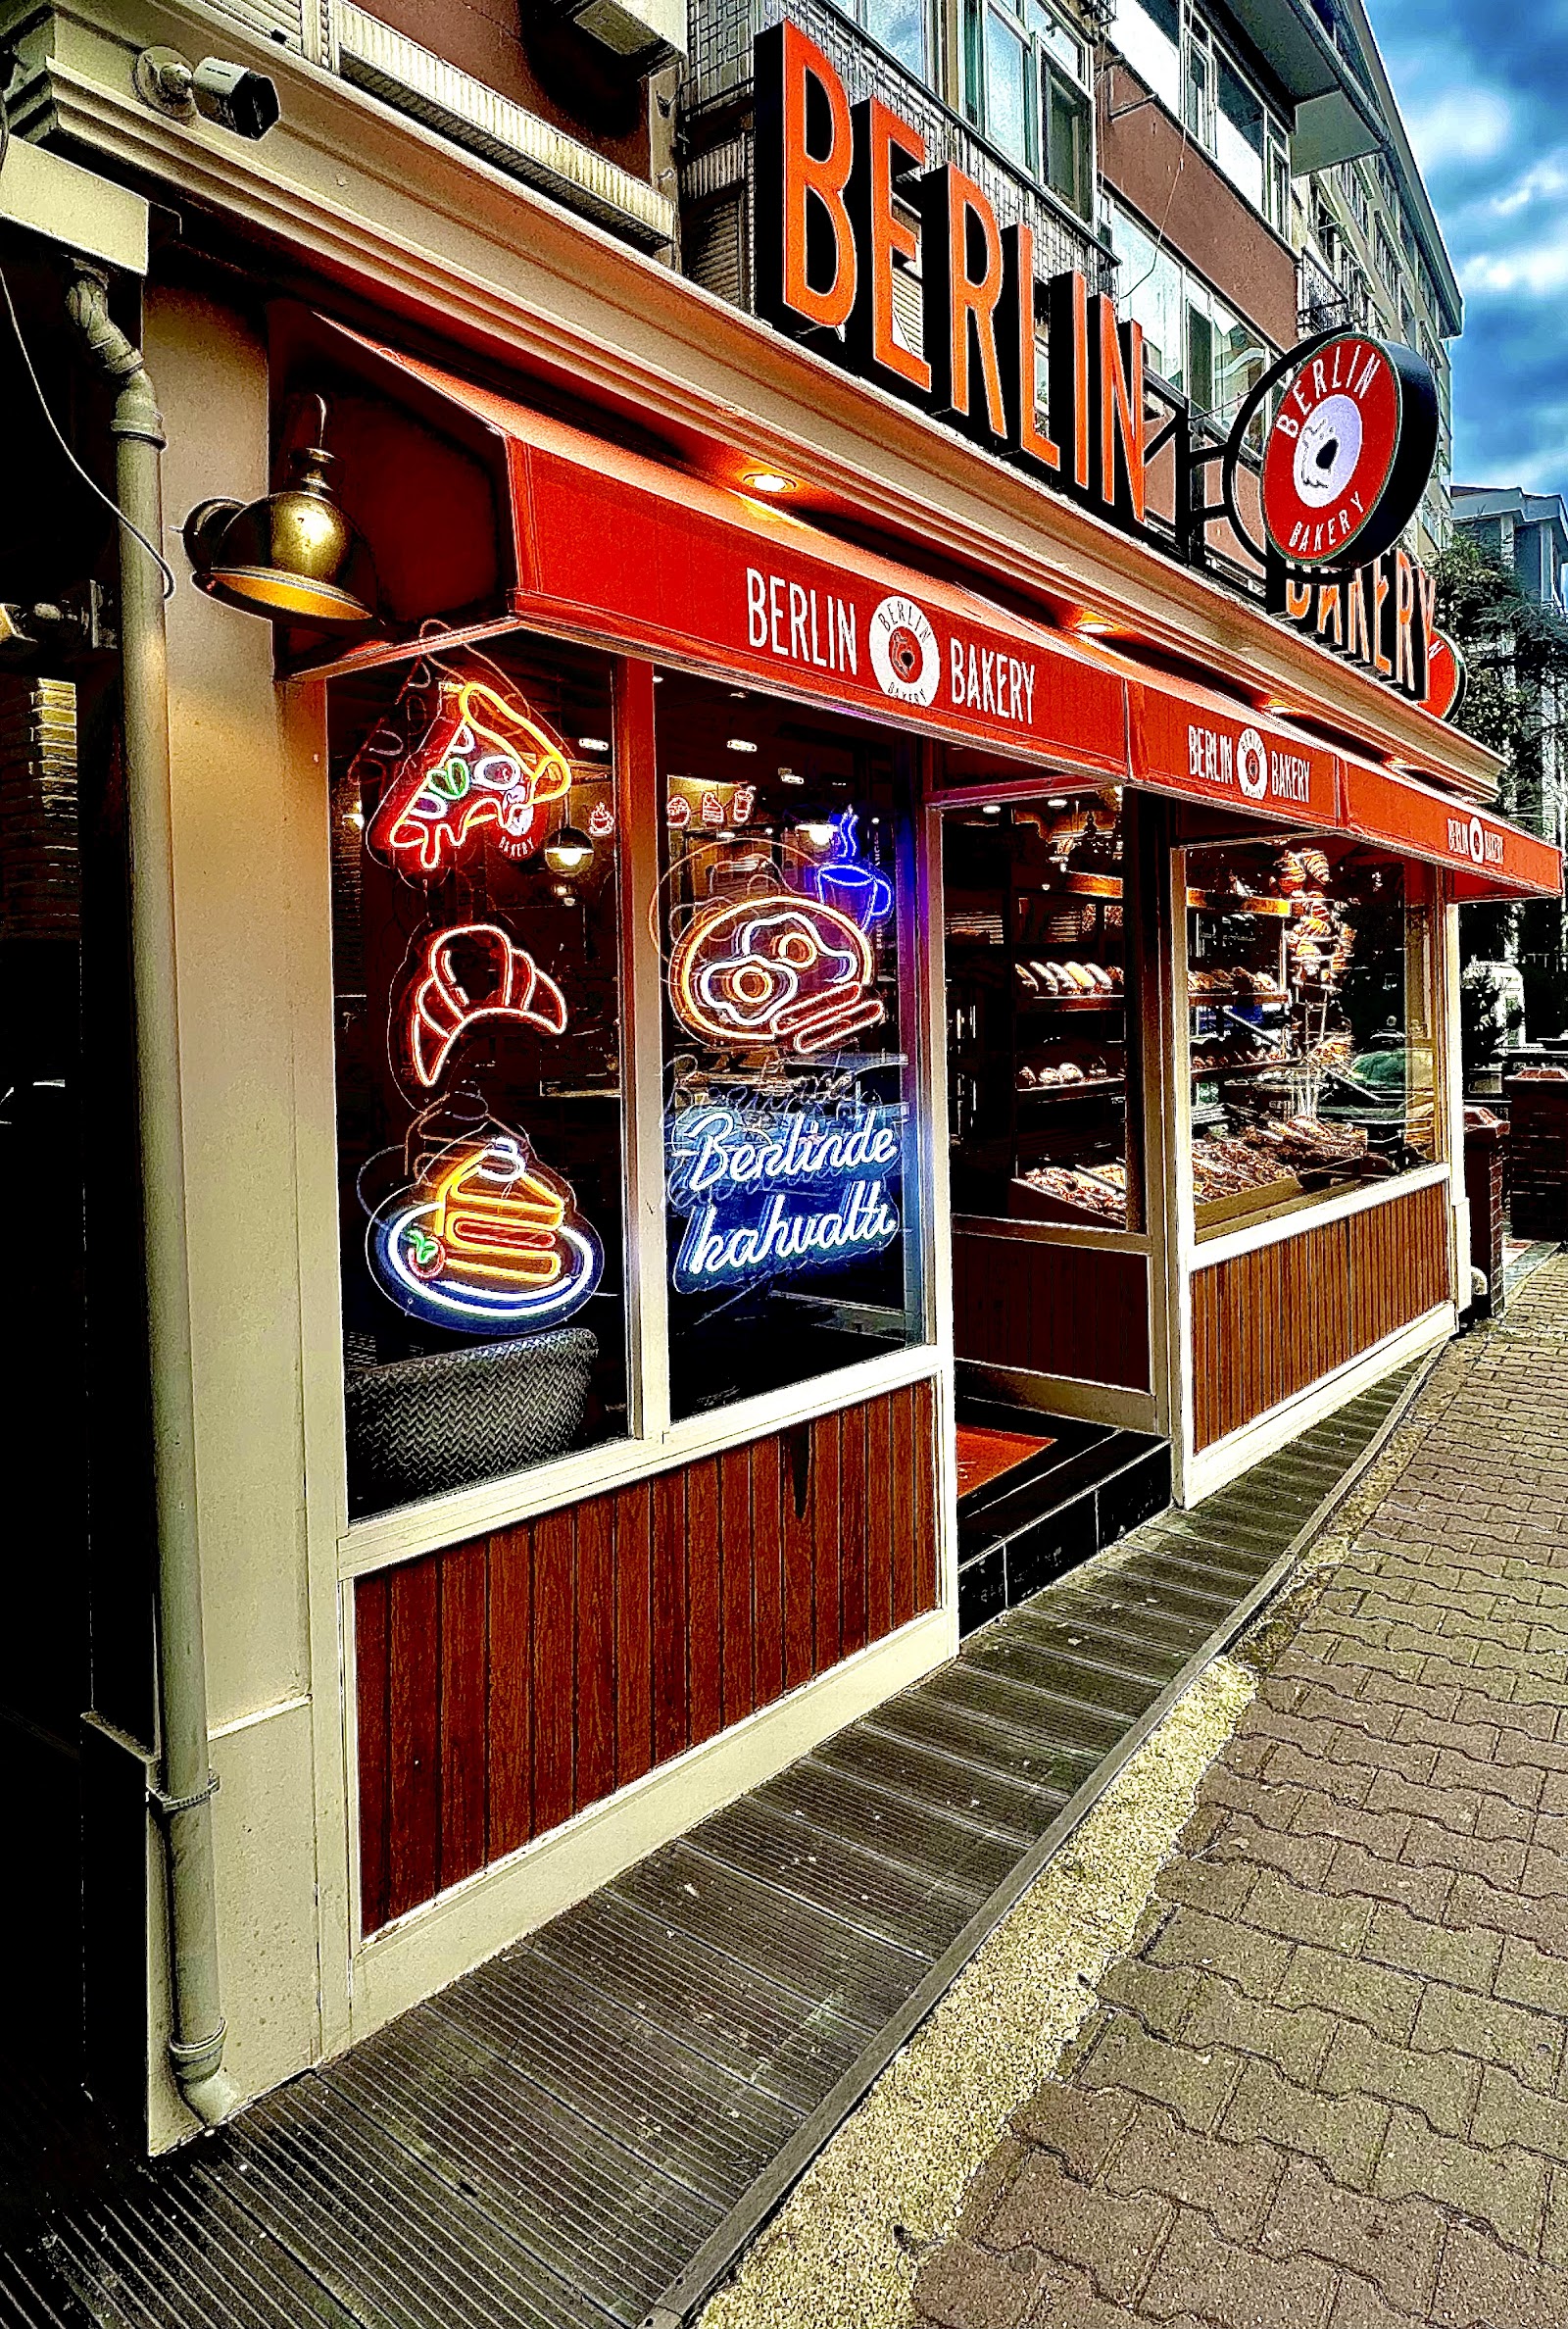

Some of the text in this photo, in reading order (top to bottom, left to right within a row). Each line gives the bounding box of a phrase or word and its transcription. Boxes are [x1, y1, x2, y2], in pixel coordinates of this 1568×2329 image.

[782, 17, 1146, 523] BERLIN
[1275, 344, 1381, 439] BERLIN
[1289, 490, 1364, 552] BAKERY
[746, 567, 1036, 724] BERLIN BAKERY
[877, 600, 932, 644] BERLIN
[1286, 547, 1437, 702] KERY
[1188, 724, 1310, 803] BERLIN BAKERY
[499, 836, 534, 858] BAKERY
[672, 1109, 898, 1190] Berlinde
[689, 1180, 896, 1274] kahvaltı
